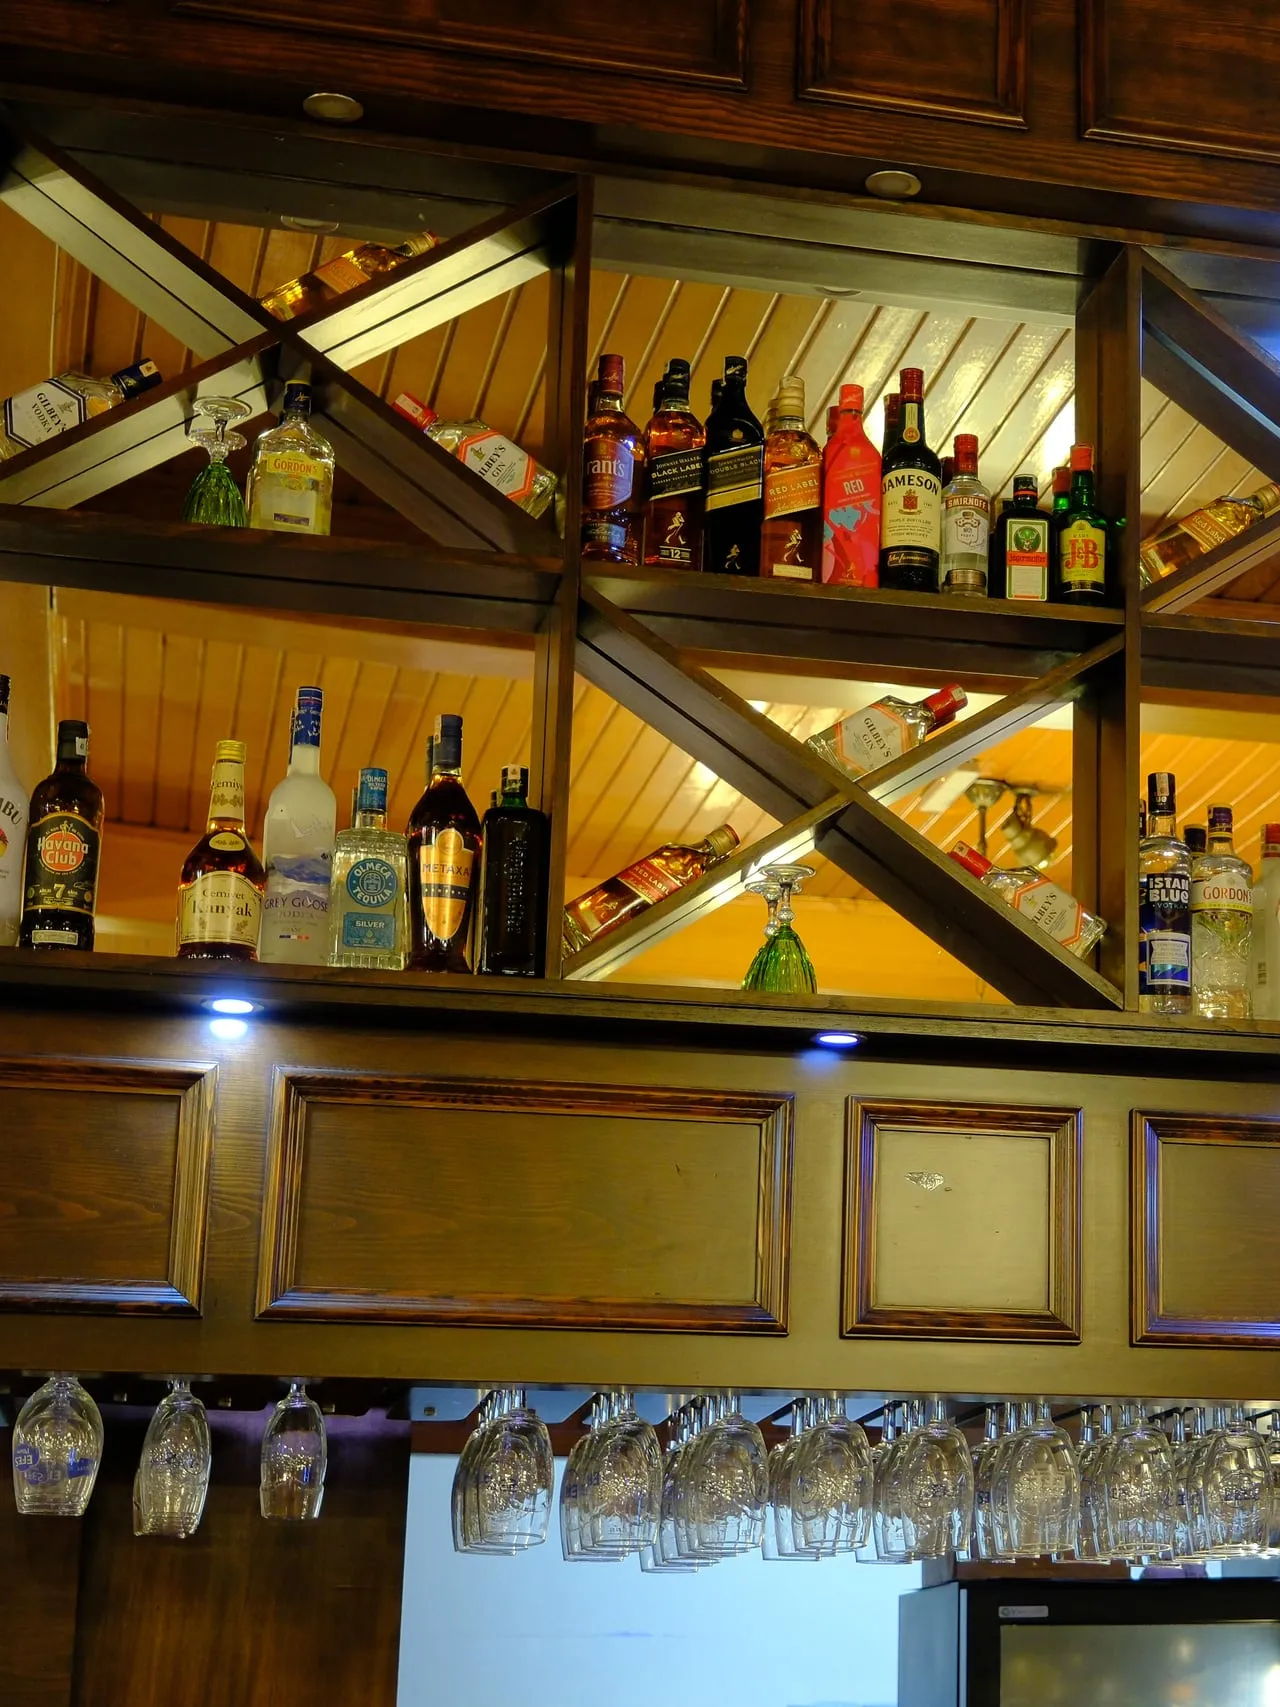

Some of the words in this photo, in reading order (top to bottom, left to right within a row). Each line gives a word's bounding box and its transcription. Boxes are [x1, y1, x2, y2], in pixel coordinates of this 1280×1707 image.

[31, 403, 53, 433] VODKA
[273, 458, 319, 474] GORDON'S
[478, 443, 506, 477] ILBEY'S
[586, 459, 625, 477] rant's
[491, 462, 506, 478] GIN
[651, 467, 679, 480] BLACK
[769, 486, 788, 496] RED
[790, 478, 819, 491] LABEL
[844, 479, 864, 495] RED
[882, 475, 939, 496] JAMESON
[947, 496, 988, 509] SMIRNOFF
[1193, 515, 1207, 529] Red
[1206, 526, 1226, 544] Label
[671, 548, 680, 559] 12
[1064, 539, 1099, 569] J&B
[862, 733, 874, 750] GIN
[863, 717, 892, 758] GILBEY'S
[37, 836, 89, 854] Havana
[45, 850, 77, 865] Club
[353, 862, 394, 878] OLMECA
[422, 863, 470, 878] METAXA
[53, 883, 66, 899] 7
[352, 889, 394, 905] TEQUILA
[264, 897, 288, 910] GREY
[291, 896, 328, 913] GOOSE
[1032, 892, 1056, 924] ILBEY'S
[1157, 902, 1185, 910] VOTKA
[355, 920, 385, 930] SILVER
[1044, 910, 1057, 926] GIN
